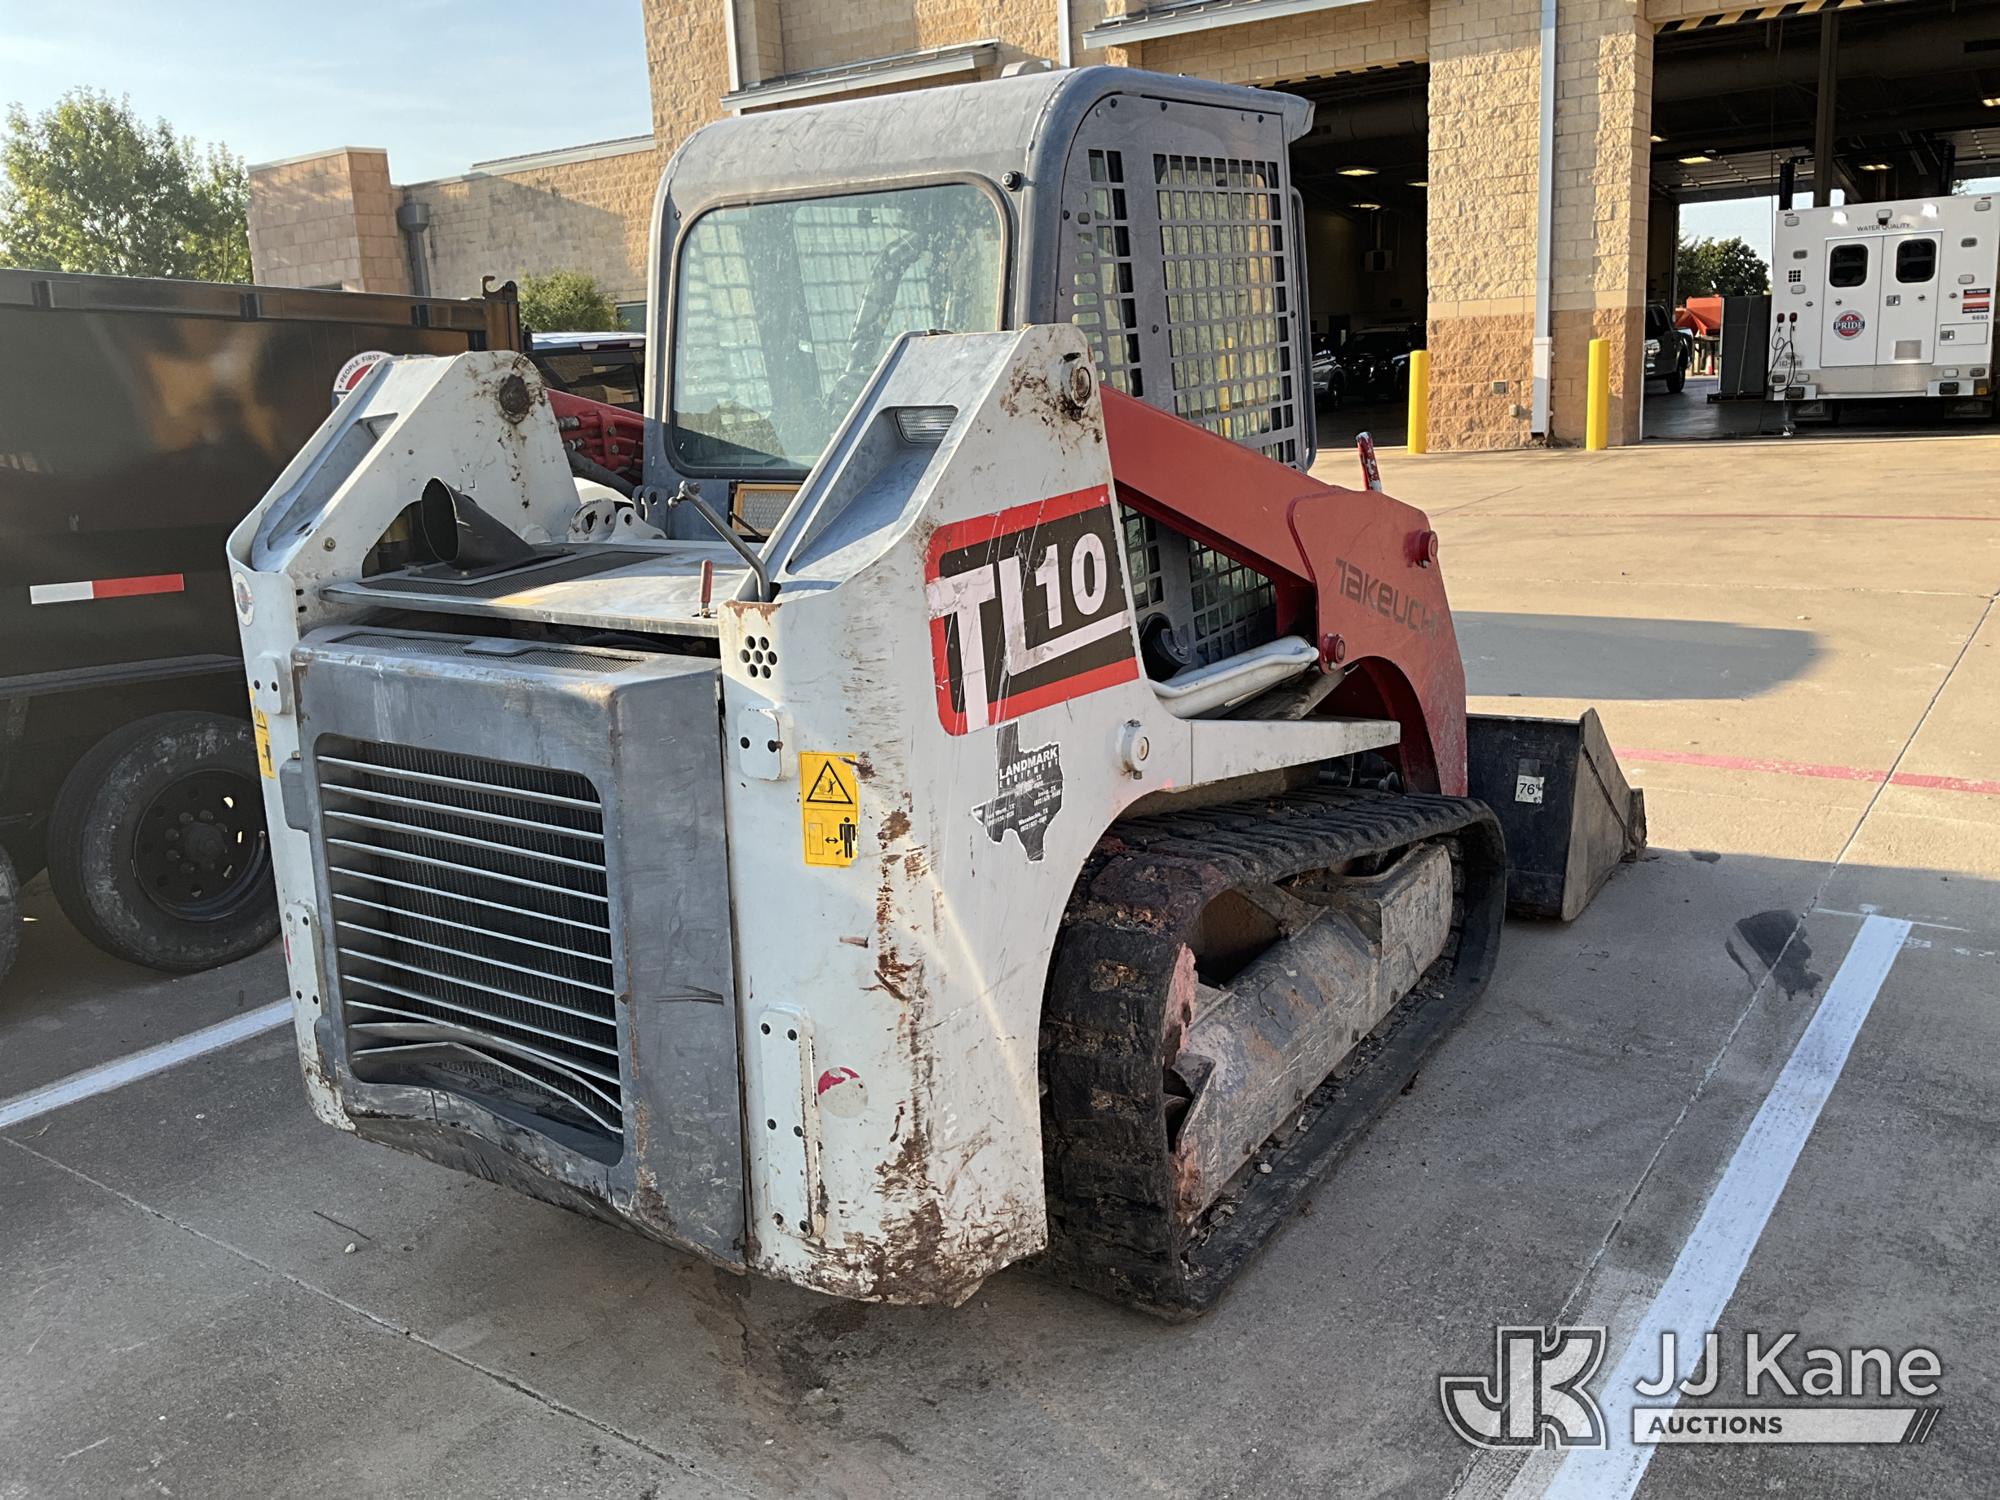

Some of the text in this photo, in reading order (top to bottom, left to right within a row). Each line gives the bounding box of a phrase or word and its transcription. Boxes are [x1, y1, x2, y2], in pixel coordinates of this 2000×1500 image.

[1836, 321, 1864, 331] PRIDE
[340, 354, 380, 383] PEOPLE FIRST
[1000, 747, 1058, 780] LANDMARK
